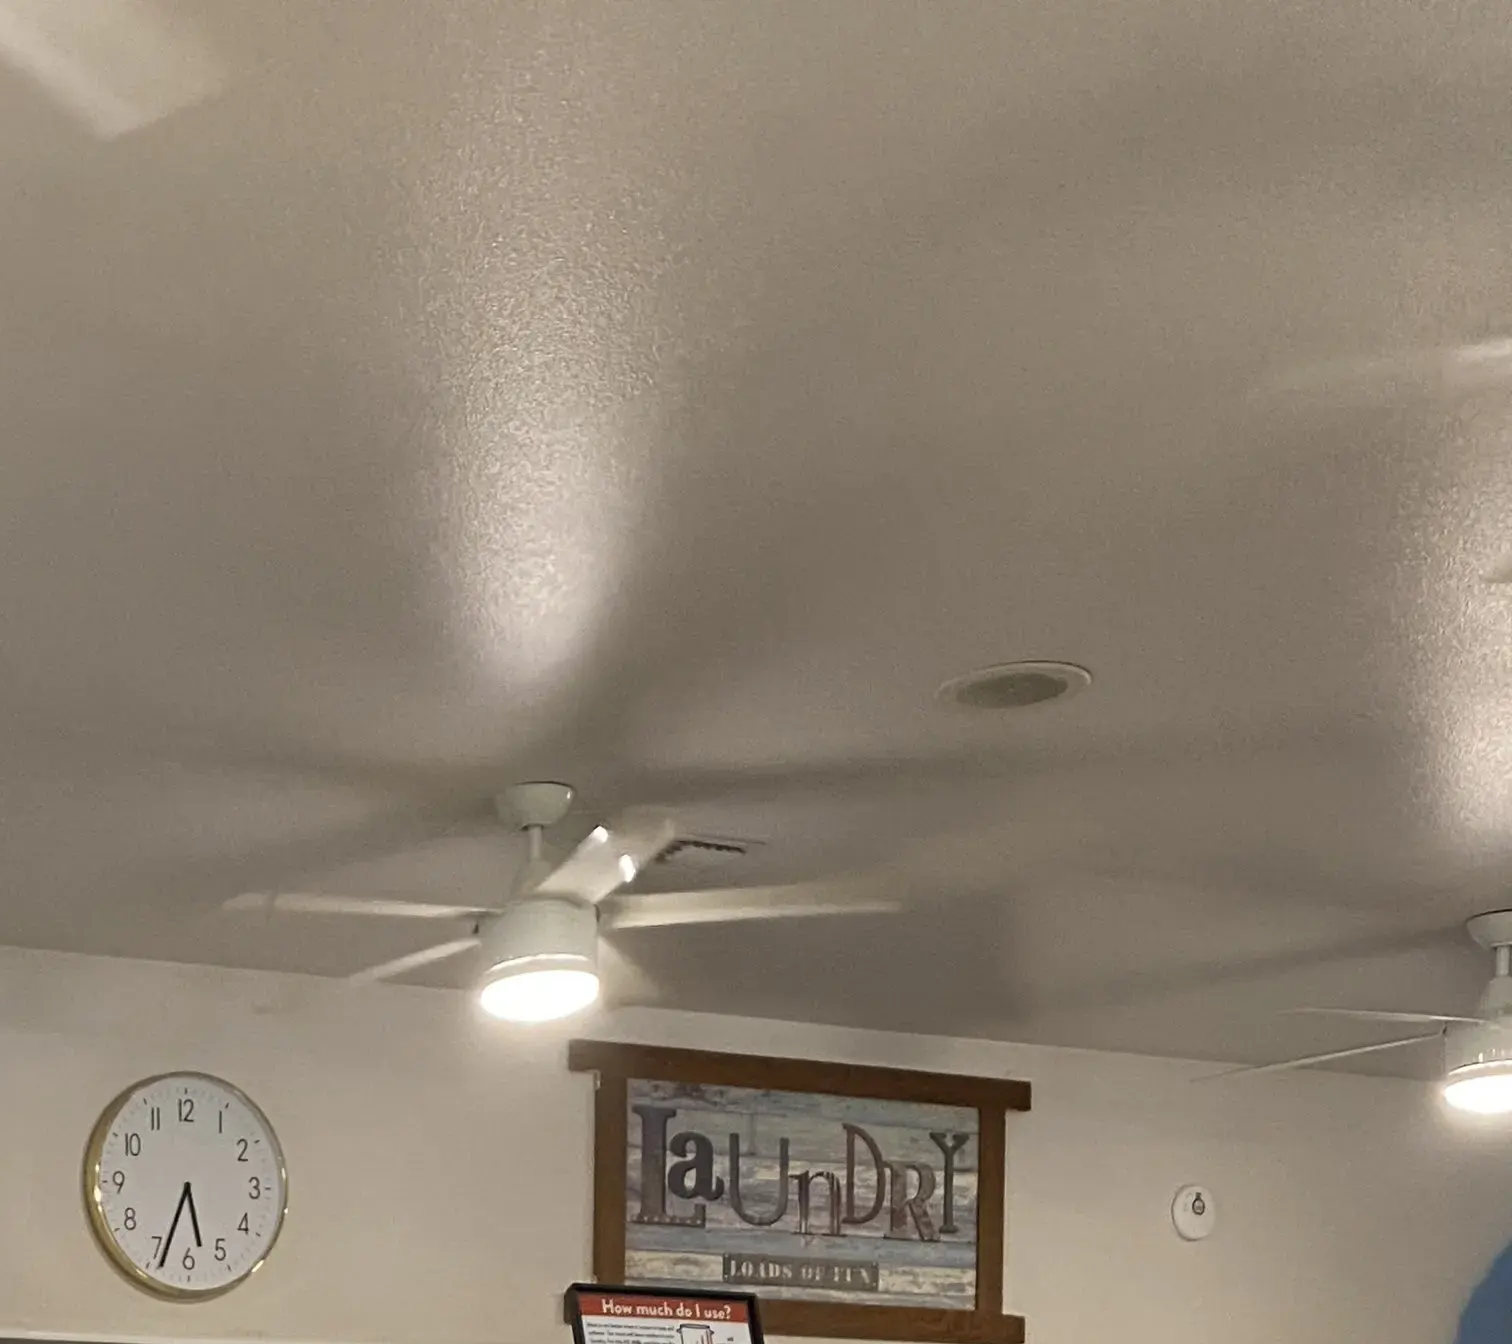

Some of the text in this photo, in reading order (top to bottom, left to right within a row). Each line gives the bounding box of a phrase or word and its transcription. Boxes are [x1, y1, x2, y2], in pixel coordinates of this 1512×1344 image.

[150, 1107, 161, 1131] 11
[178, 1098, 194, 1122] 12
[124, 1133, 141, 1157] 10
[236, 1138, 249, 1162] 2
[112, 1170, 125, 1194] 9
[248, 1176, 261, 1200] 3
[123, 1207, 137, 1231] 8
[237, 1212, 249, 1235] 4
[151, 1236, 163, 1260] 7
[182, 1247, 195, 1270] 6
[214, 1238, 227, 1261] 5
[602, 1299, 632, 1314] How
[636, 1301, 673, 1317] much
[676, 1302, 692, 1318] do
[704, 1305, 731, 1319] use?
